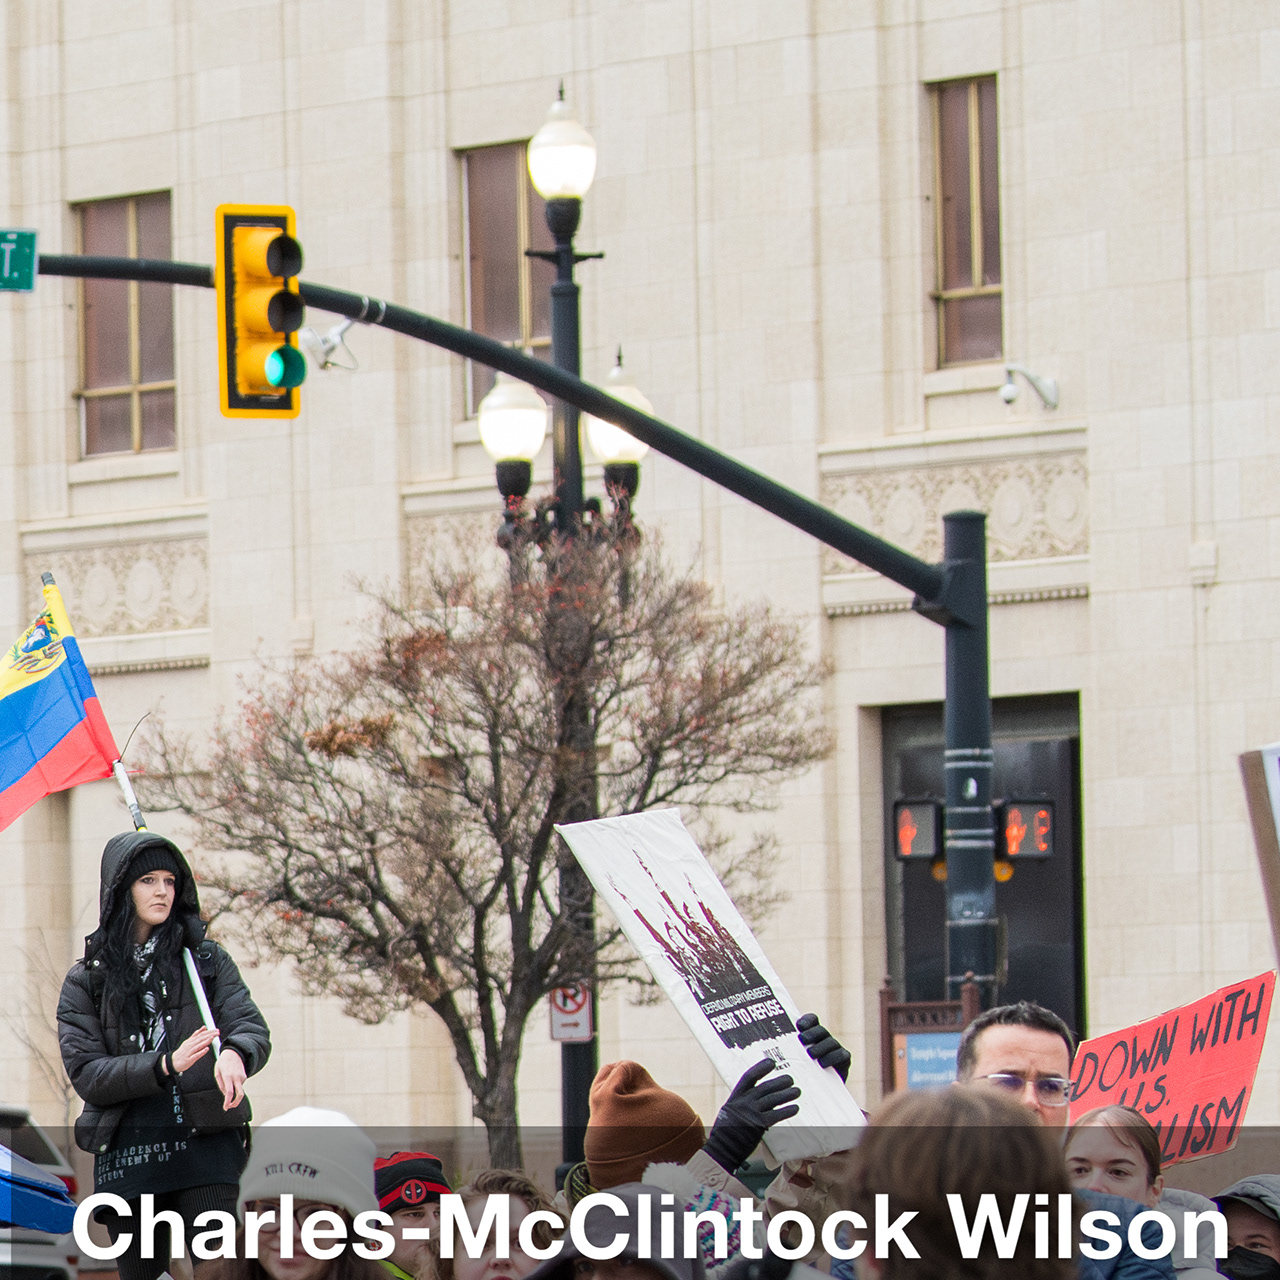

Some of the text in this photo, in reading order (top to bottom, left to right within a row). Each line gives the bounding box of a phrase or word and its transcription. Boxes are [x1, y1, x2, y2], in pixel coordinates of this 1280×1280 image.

[709, 1009, 740, 1035] RIGHT
[746, 997, 785, 1023] REFUSE
[1070, 982, 1266, 1102] DOWN WITH
[115, 1152, 150, 1169] ENEMY
[98, 1168, 125, 1185] STUDY
